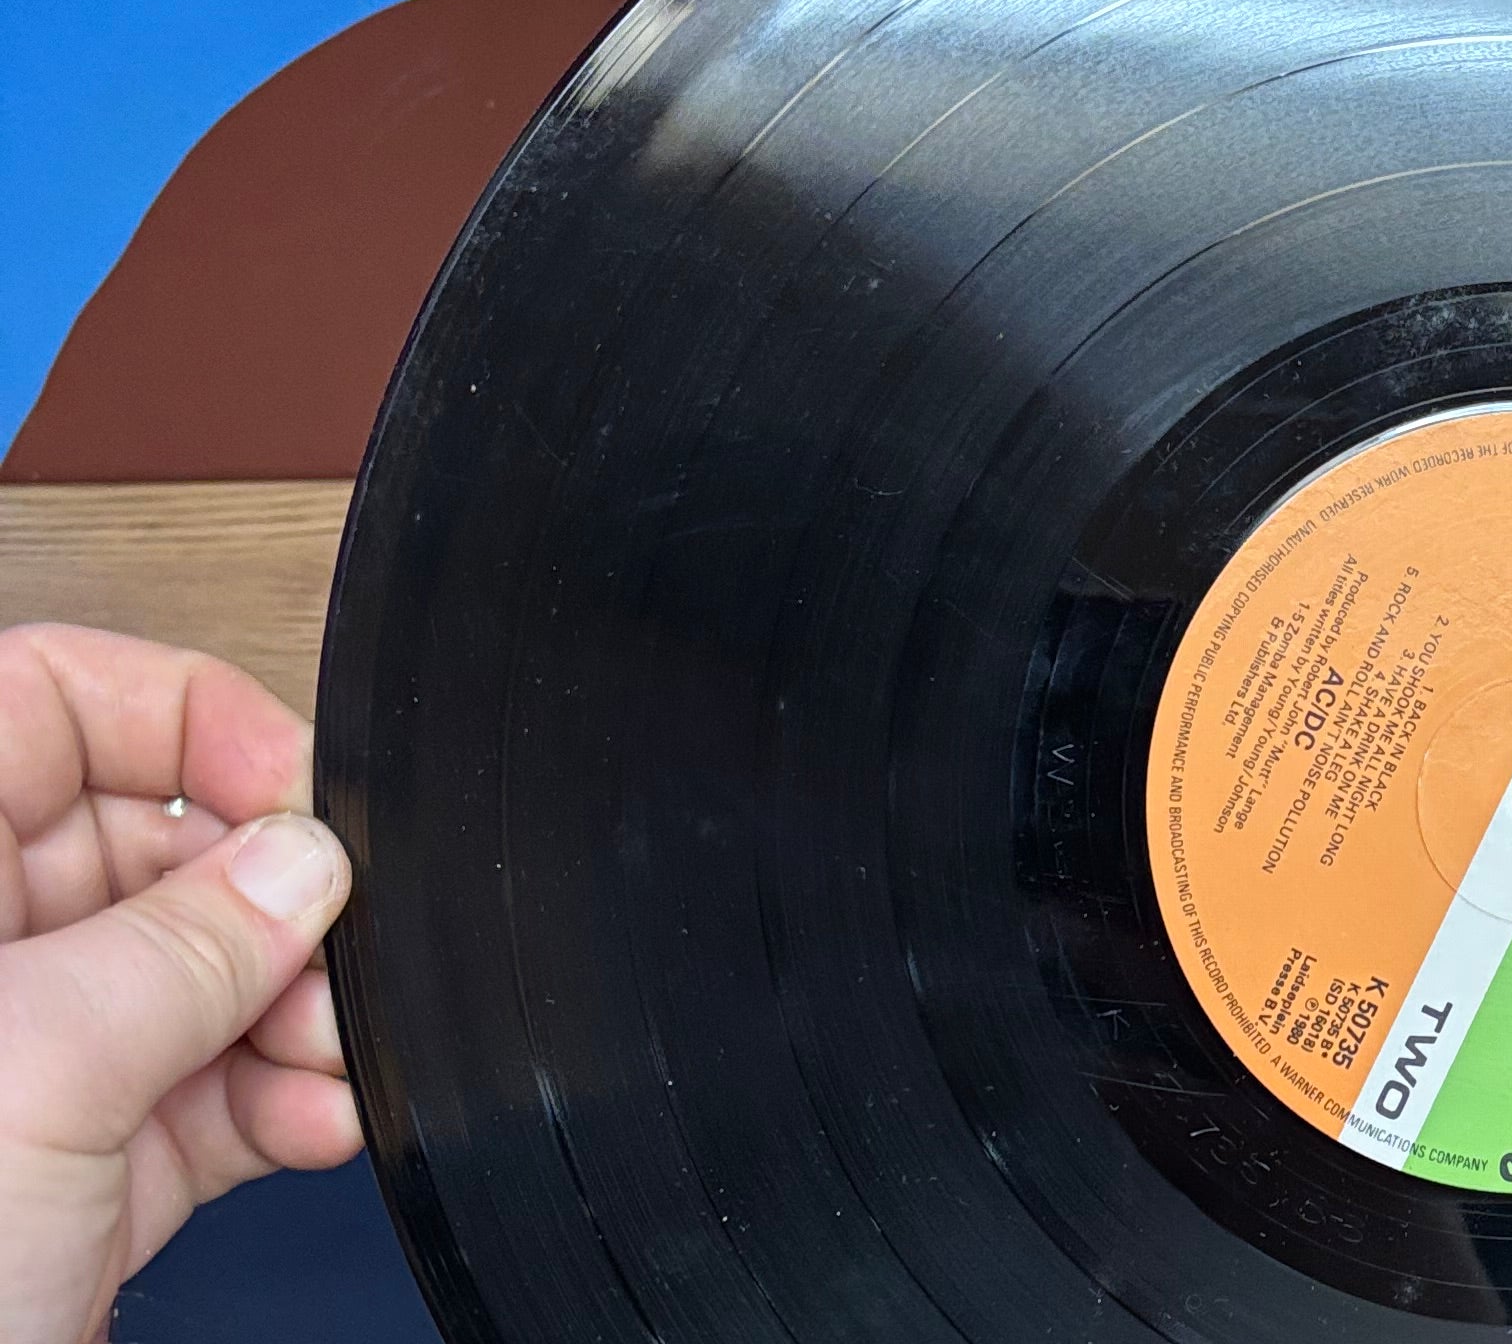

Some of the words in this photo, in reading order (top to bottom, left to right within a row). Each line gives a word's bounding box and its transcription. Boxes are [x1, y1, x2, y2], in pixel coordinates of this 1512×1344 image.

[1411, 446, 1474, 474] RECORDED
[1476, 443, 1498, 458] THE
[1372, 464, 1411, 489] WORK
[1317, 481, 1375, 522] RESERVED
[1243, 518, 1318, 593] UNAUTHORISED
[1339, 552, 1358, 574] All
[1323, 573, 1348, 608] titles
[1328, 569, 1369, 636] Produced
[1381, 580, 1412, 625] ROCK
[1212, 590, 1250, 641] COPYING
[1268, 615, 1285, 630] &
[1299, 606, 1331, 655] written
[1192, 639, 1221, 683] PUBLIC
[1267, 621, 1300, 671] Zomba
[1317, 633, 1337, 654] by
[1364, 623, 1390, 660] AND
[1416, 631, 1443, 666] YOU
[1234, 629, 1278, 700] Publishers
[1289, 654, 1309, 675] by
[1295, 652, 1328, 701] Robert
[1344, 658, 1374, 699] ROLL
[1378, 663, 1408, 708] HAVE
[1223, 669, 1277, 760] Management
[1292, 665, 1346, 752] AC/DC
[1344, 685, 1379, 739] SHAKE
[1371, 706, 1386, 720] A
[1389, 664, 1426, 720] SHOOK
[1170, 682, 1203, 772] PERFORMANCE
[1278, 699, 1305, 737] John
[1325, 698, 1354, 743] AIN'T
[1377, 718, 1399, 745] ME
[1397, 698, 1427, 743] BACK
[1211, 674, 1300, 836] Young/Young/Johnson
[1301, 741, 1334, 790] NOISE
[1337, 737, 1353, 751] A
[1347, 720, 1380, 770] DRINK
[1362, 743, 1386, 773] ALL
[1388, 741, 1406, 761] IN
[1168, 775, 1183, 802] AND
[1322, 751, 1347, 783] LEG
[1335, 768, 1357, 794] ON
[1363, 759, 1398, 813] BLACK
[1231, 786, 1262, 831] Lange
[1323, 793, 1345, 820] ME
[1339, 773, 1373, 825] NIGHT
[1260, 787, 1311, 875] POLLUTION
[1318, 822, 1349, 867] LONG
[1168, 806, 1193, 902] BROADCASTING
[1181, 902, 1198, 918] OF
[1187, 919, 1208, 948] THIS
[1197, 947, 1229, 994] RECORD
[1269, 946, 1303, 998] Presse
[1323, 976, 1346, 1007] (SD
[1345, 981, 1362, 996] K
[1363, 974, 1390, 1000] K
[1220, 991, 1272, 1055] PROHIBITED
[1285, 1011, 1311, 1046] 1980
[1299, 1006, 1332, 1054] 16018)
[1325, 994, 1355, 1039] 50735
[1330, 997, 1379, 1071] 50735
[1372, 996, 1454, 1122] TWO
[1268, 1053, 1283, 1068] A
[1277, 1061, 1325, 1104] WARNER
[1322, 1097, 1427, 1159] COMMUNICATIONS
[1427, 1147, 1488, 1172] COMPANY
